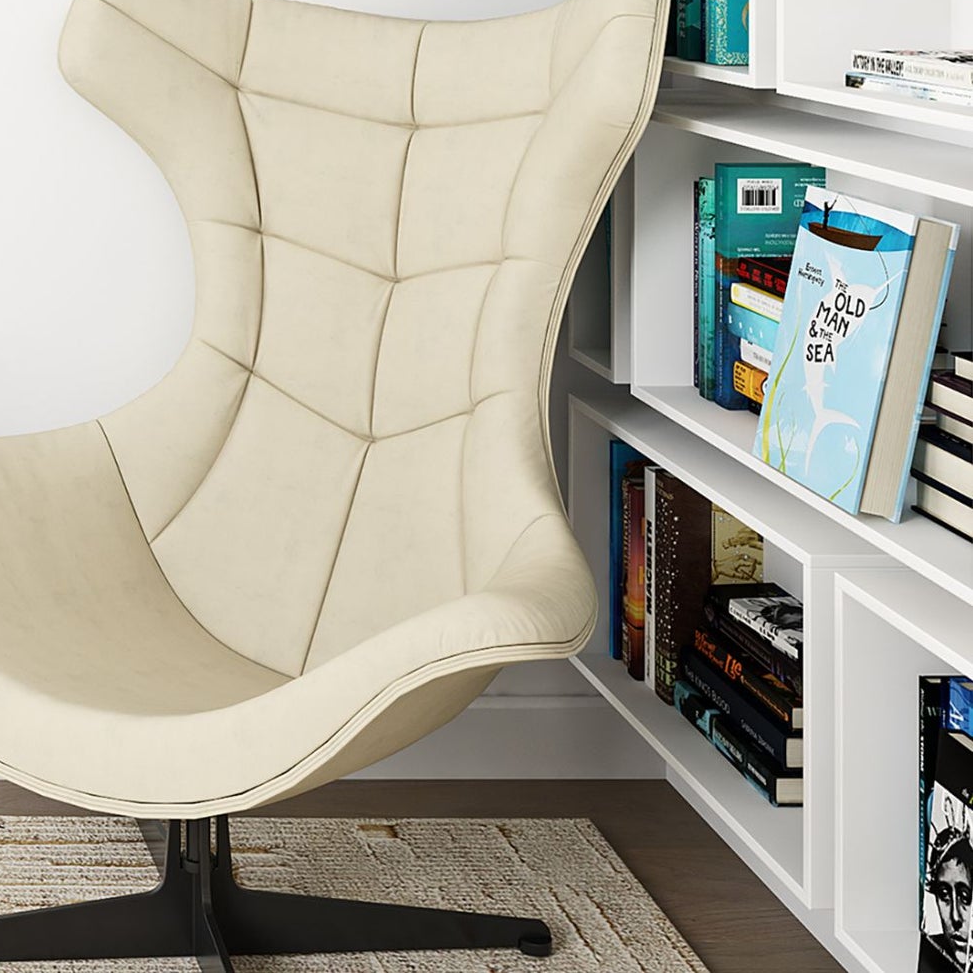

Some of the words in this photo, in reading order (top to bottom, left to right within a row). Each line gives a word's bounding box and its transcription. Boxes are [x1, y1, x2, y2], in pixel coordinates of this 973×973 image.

[835, 278, 849, 294] THE
[834, 292, 866, 318] OLD
[816, 301, 850, 338] MAN
[809, 320, 818, 338] &
[820, 328, 834, 342] THE
[806, 343, 834, 363] SEA
